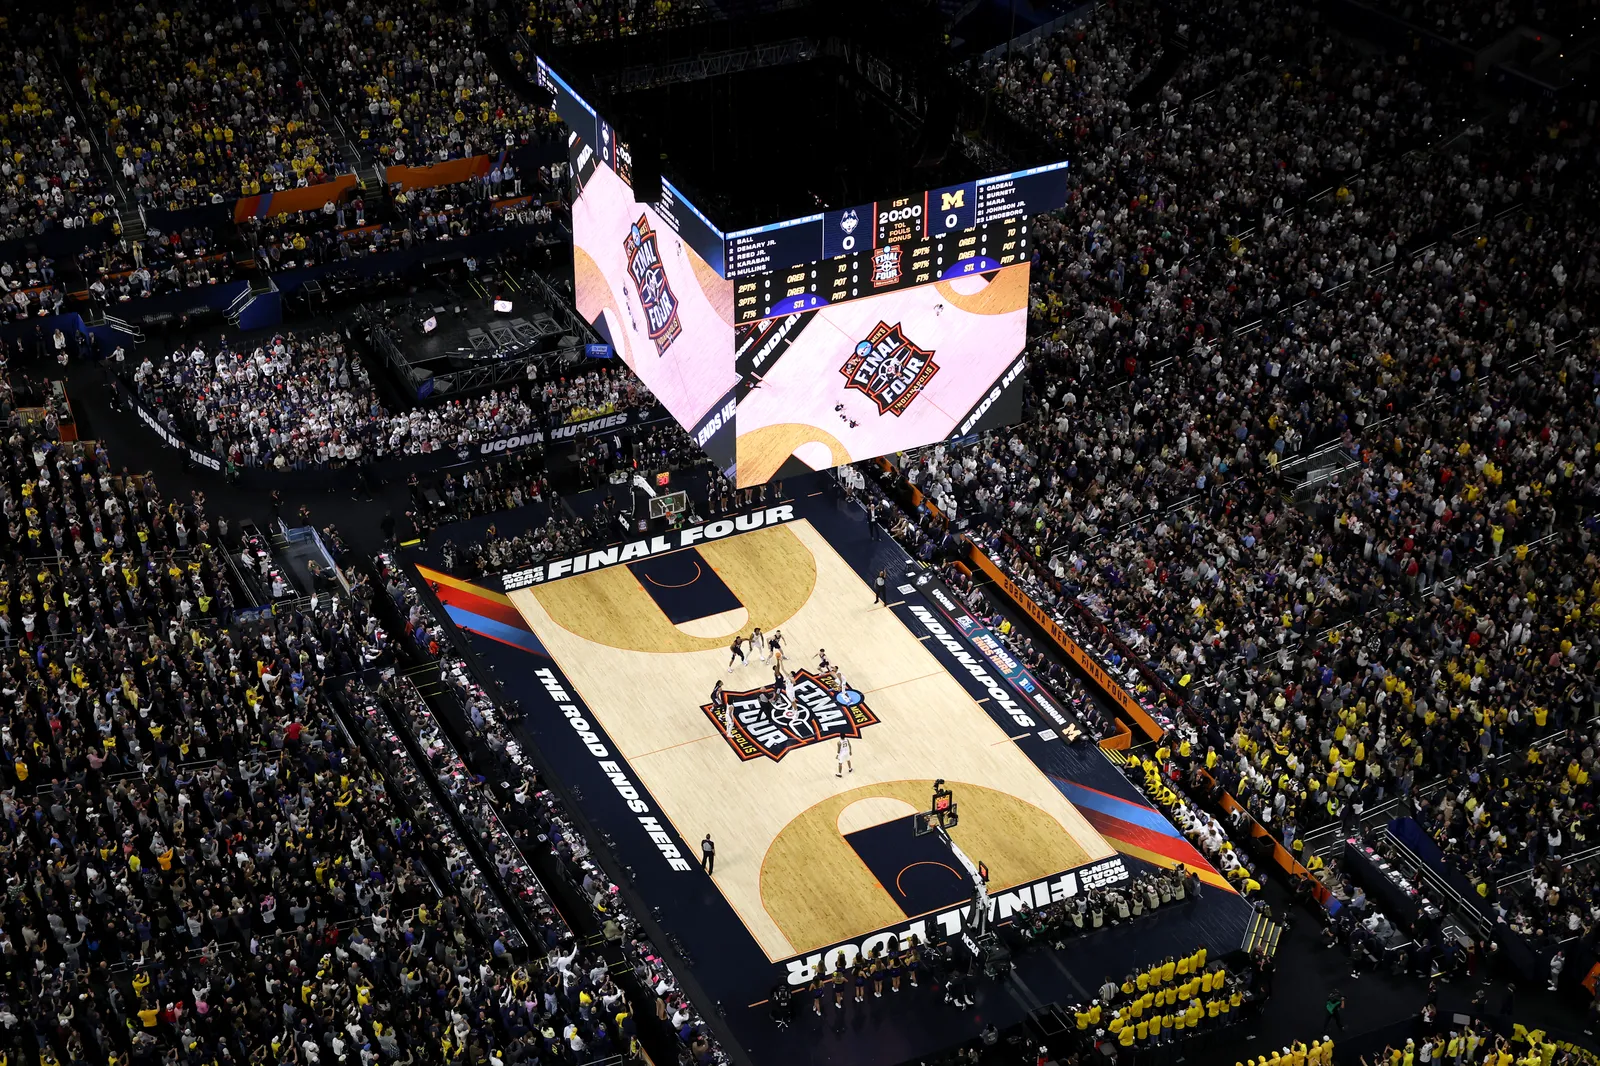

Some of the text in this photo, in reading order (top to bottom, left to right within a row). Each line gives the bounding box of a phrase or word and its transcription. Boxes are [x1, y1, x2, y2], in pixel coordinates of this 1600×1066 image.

[987, 181, 1013, 192] CADEAU
[987, 188, 1016, 199] BURNETT
[942, 190, 964, 211] M
[986, 198, 1005, 206] MARA
[879, 204, 922, 225] 20:00
[986, 203, 1016, 214] JOHNSON
[946, 214, 958, 228] 0
[986, 209, 1023, 222] LENDEBORG
[889, 228, 910, 237] FOULS
[894, 222, 906, 230] TOL
[1008, 226, 1026, 237] TO 0
[842, 236, 855, 250] 0
[888, 234, 912, 244] BONUS
[982, 234, 987, 242] 0
[737, 242, 766, 252] DEMARY
[938, 244, 943, 252] 0
[1002, 239, 1026, 251] POT 0
[737, 252, 755, 260] REED
[875, 252, 898, 264] FINAL
[982, 248, 986, 256] 0
[1020, 252, 1026, 260] 0
[632, 240, 656, 284] FINAL
[737, 256, 770, 268] KARABAN
[838, 262, 858, 272] TO 0
[938, 257, 942, 265] 0
[737, 264, 766, 276] MULLINS
[812, 270, 816, 278] 0
[876, 268, 898, 280] FOUR
[937, 270, 942, 278] 0
[964, 264, 974, 272] STL
[765, 280, 770, 288] 0
[812, 284, 816, 292] 0
[834, 275, 858, 288] POT 0
[765, 294, 770, 302] 0
[852, 288, 858, 296] 0
[648, 290, 672, 332] FOUR
[765, 306, 770, 315] 0
[794, 300, 804, 309] STL
[870, 328, 886, 344] MEN'S
[855, 336, 900, 384] FINAL
[882, 357, 924, 404] FOUR
[895, 366, 933, 409] INDIANAPOLIS
[960, 356, 1026, 436] ENDS HE
[138, 406, 166, 440] UCONN
[480, 413, 628, 454] UCONN HUSKIES
[698, 413, 722, 448] ENDS
[548, 504, 794, 580] FINAL FOUR
[502, 566, 544, 580] 2026
[504, 571, 544, 586] NCAA
[505, 576, 544, 590] MEN'S
[932, 588, 956, 612] UCONN
[972, 636, 1014, 674] ENDS HERE
[980, 634, 1018, 668] THE ROAD
[1026, 601, 1046, 625] NCAA
[1051, 624, 1075, 654] MEN'S
[1082, 656, 1104, 684] FINAL
[1107, 682, 1128, 708] FOUR
[908, 606, 1036, 727] INDIANAPOLIS
[793, 680, 848, 732] FINAL
[1033, 694, 1066, 726] MICHIGAN
[850, 706, 868, 723] MEN'S
[732, 699, 788, 749] FOUR
[1062, 723, 1082, 742] M
[534, 668, 692, 871] THE ROAD ENDS HERE
[1079, 858, 1122, 877] MEN'S
[1081, 865, 1126, 884] NCAA
[962, 932, 980, 958] NCAA
